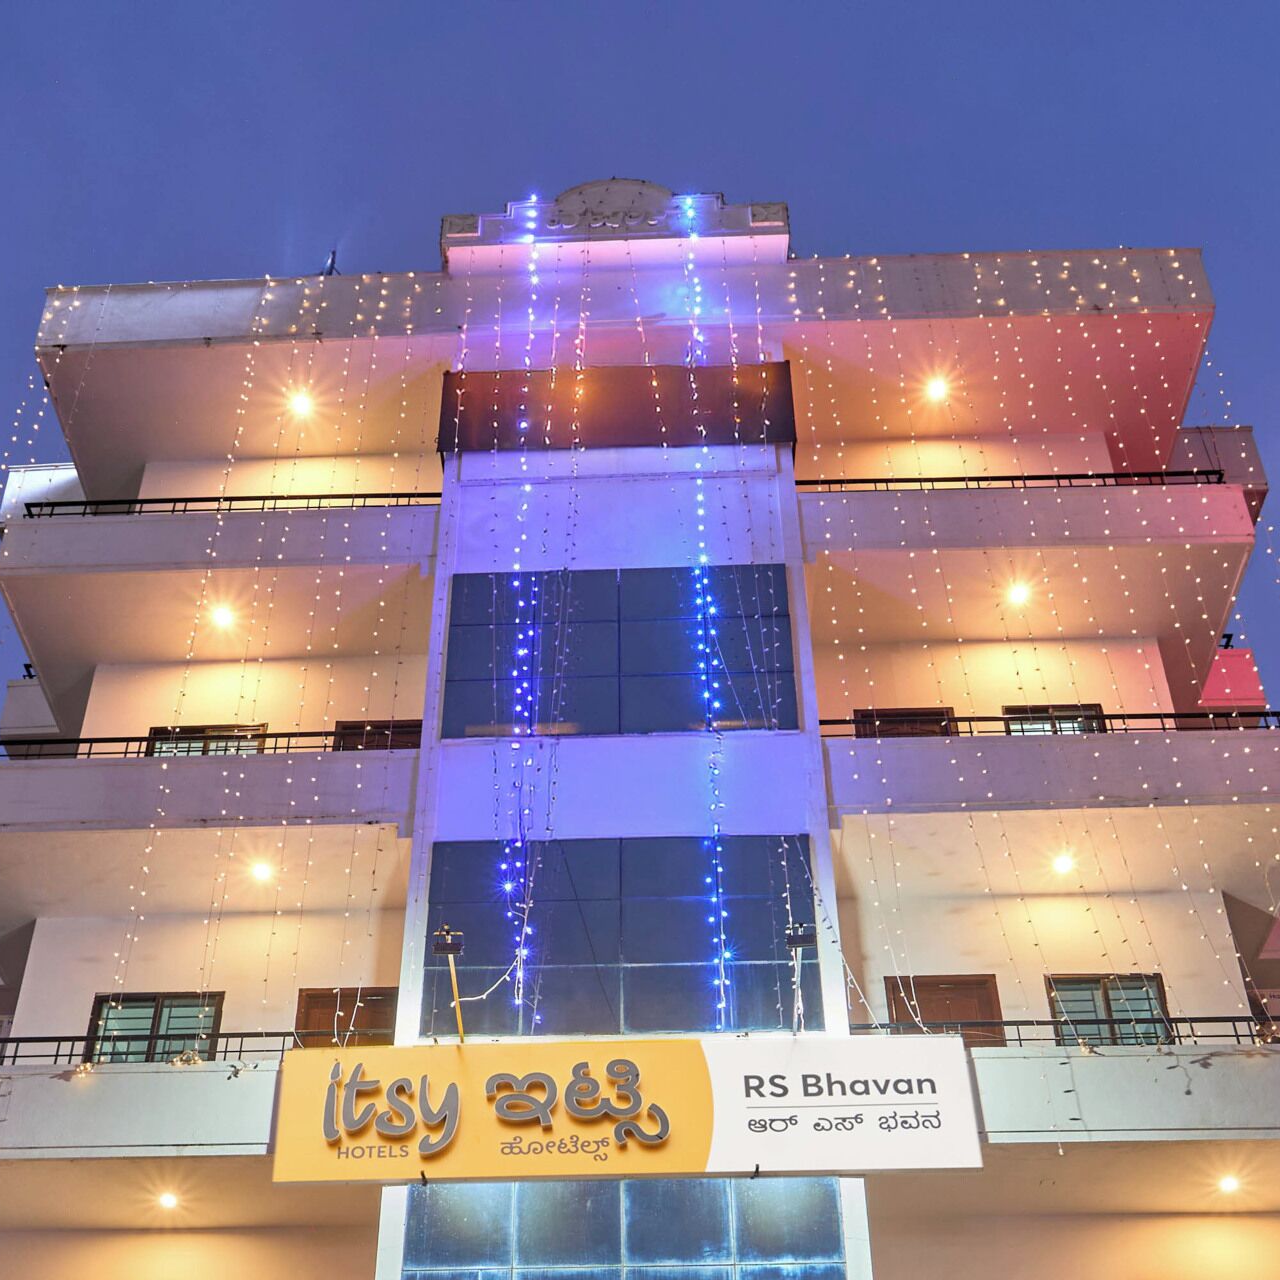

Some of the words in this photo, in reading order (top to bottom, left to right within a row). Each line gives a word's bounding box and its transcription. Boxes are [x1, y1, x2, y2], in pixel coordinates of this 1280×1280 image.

[743, 1074, 789, 1098] RS
[801, 1072, 937, 1097] Bhavan
[322, 1061, 461, 1158] itsy
[747, 1114, 798, 1133] ಆರ್
[813, 1113, 863, 1132] ಎಸ್
[878, 1110, 942, 1133] ಭವನ
[337, 1145, 409, 1160] HOTELS
